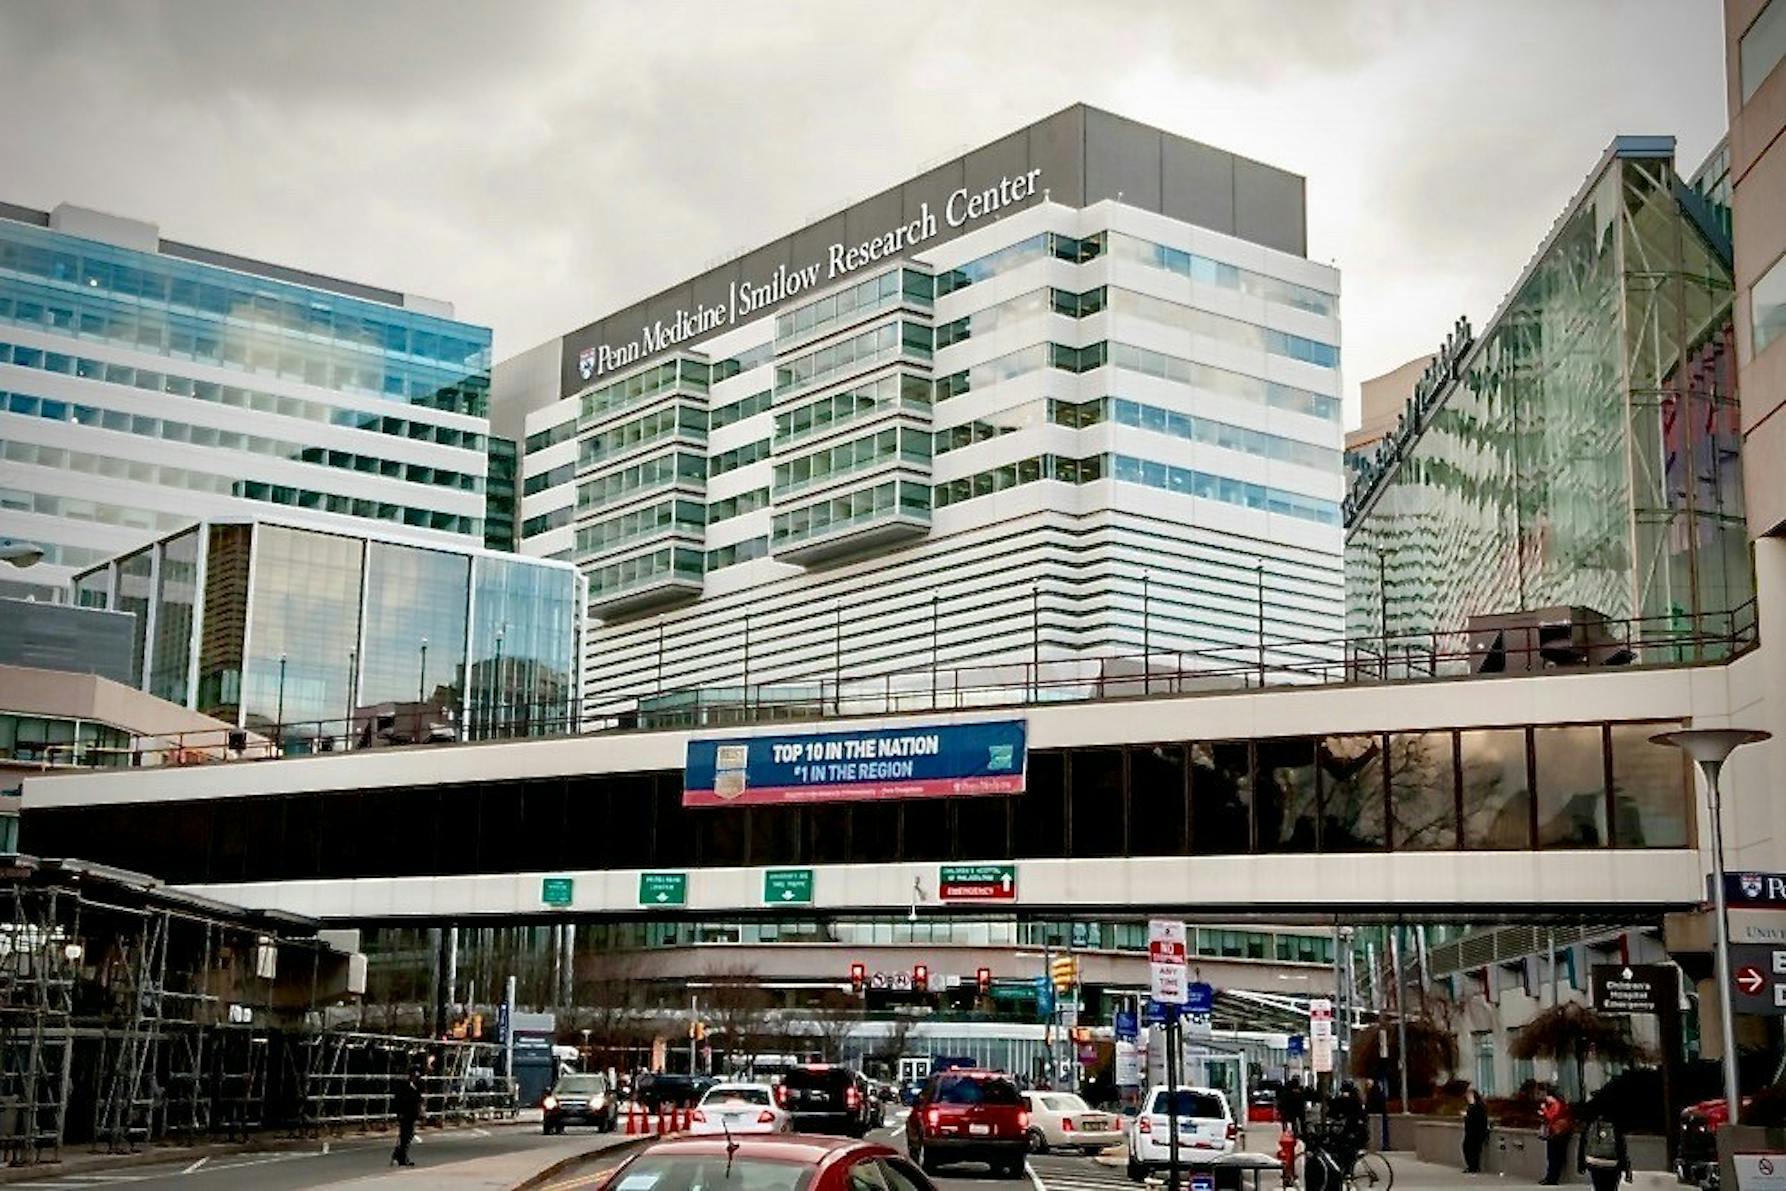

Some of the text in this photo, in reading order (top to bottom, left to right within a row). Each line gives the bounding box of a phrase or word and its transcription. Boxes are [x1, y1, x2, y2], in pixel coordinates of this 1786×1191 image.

[597, 168, 1042, 375] Penn Medicine Smilow Research Center
[773, 735, 939, 763] TOP 10 IN THE NATION
[810, 764, 825, 782] IN
[827, 763, 856, 781] THE
[858, 760, 913, 781] REGION
[1606, 981, 1651, 991] Children's
[1610, 991, 1648, 1001] Hospital
[1603, 999, 1655, 1010] Emergency
